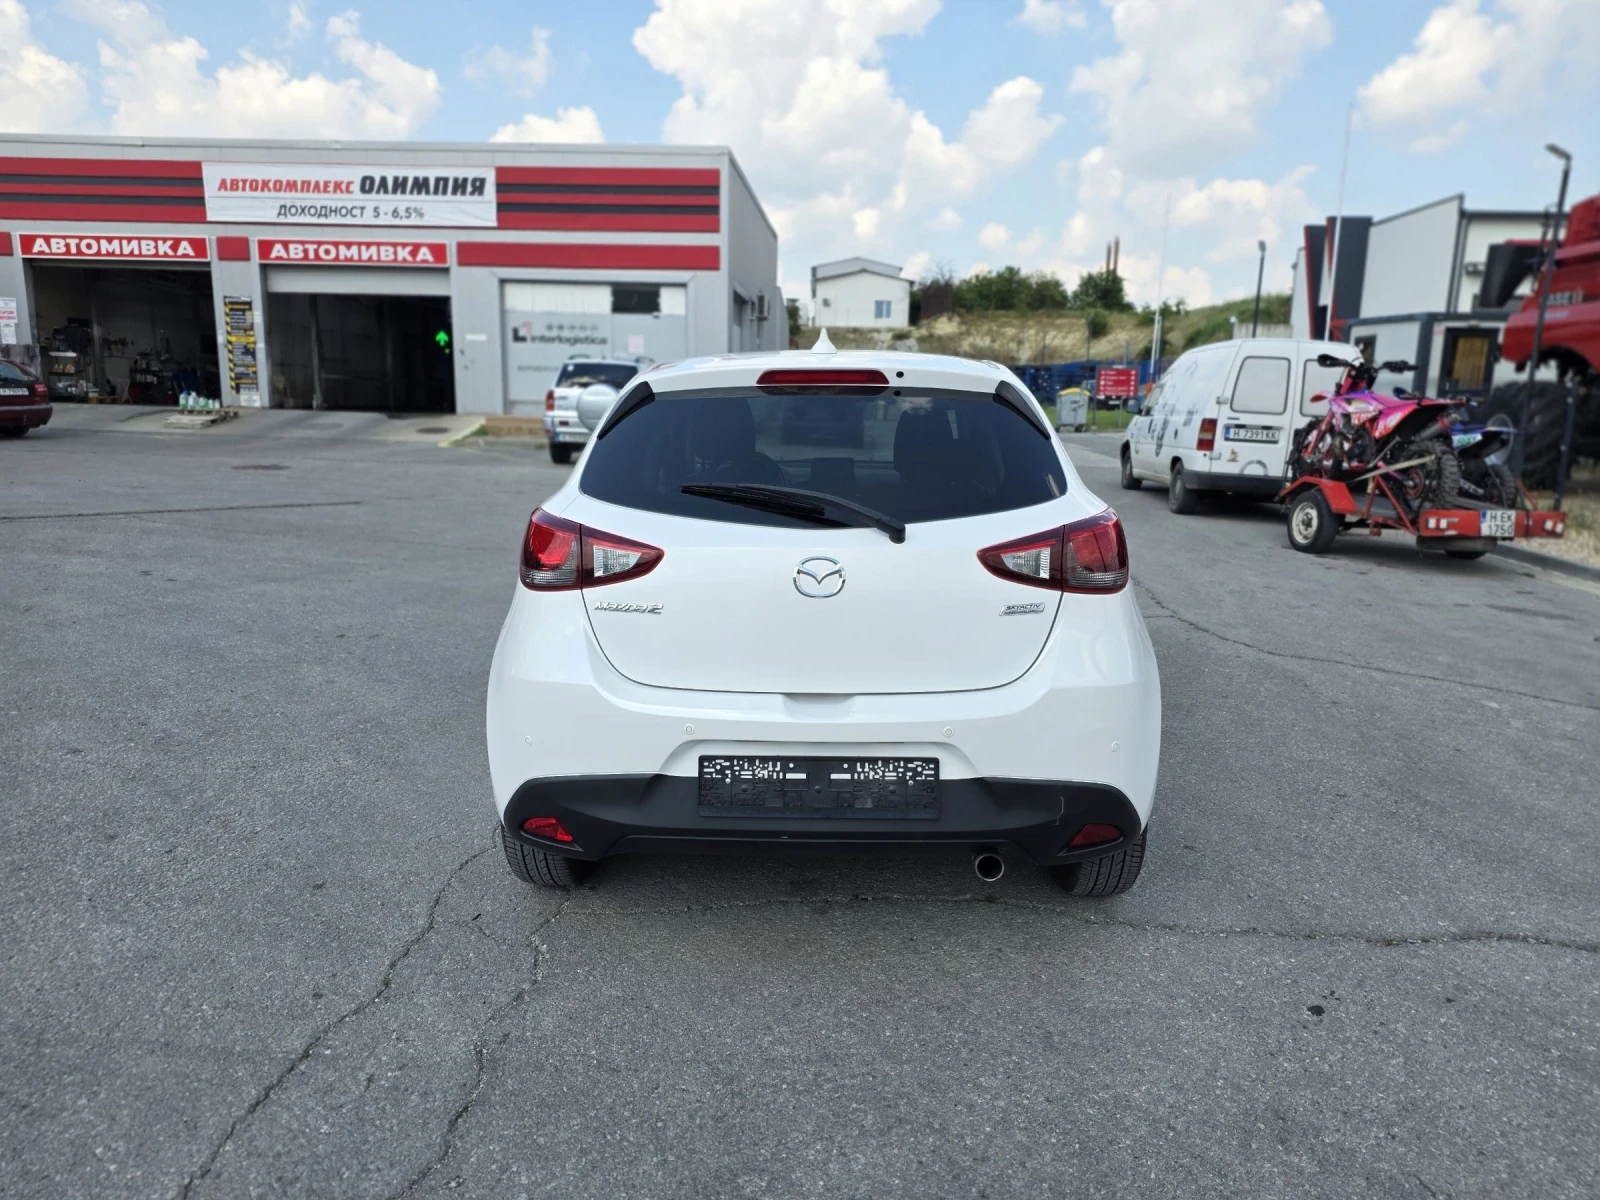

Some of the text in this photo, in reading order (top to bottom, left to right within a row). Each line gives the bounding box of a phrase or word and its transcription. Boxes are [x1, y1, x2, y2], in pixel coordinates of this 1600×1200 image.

[217, 175, 487, 196] АВТОКОМПЛЕКС ОЛИМПИЯ
[277, 204, 366, 219] ДОХОДНОСТ
[372, 207, 380, 218] 5
[391, 207, 425, 220] 6,5%
[32, 237, 196, 256] АВТОМИВКА
[269, 243, 434, 262] АВТОМИВКА
[1488, 524, 1513, 536] 1750
